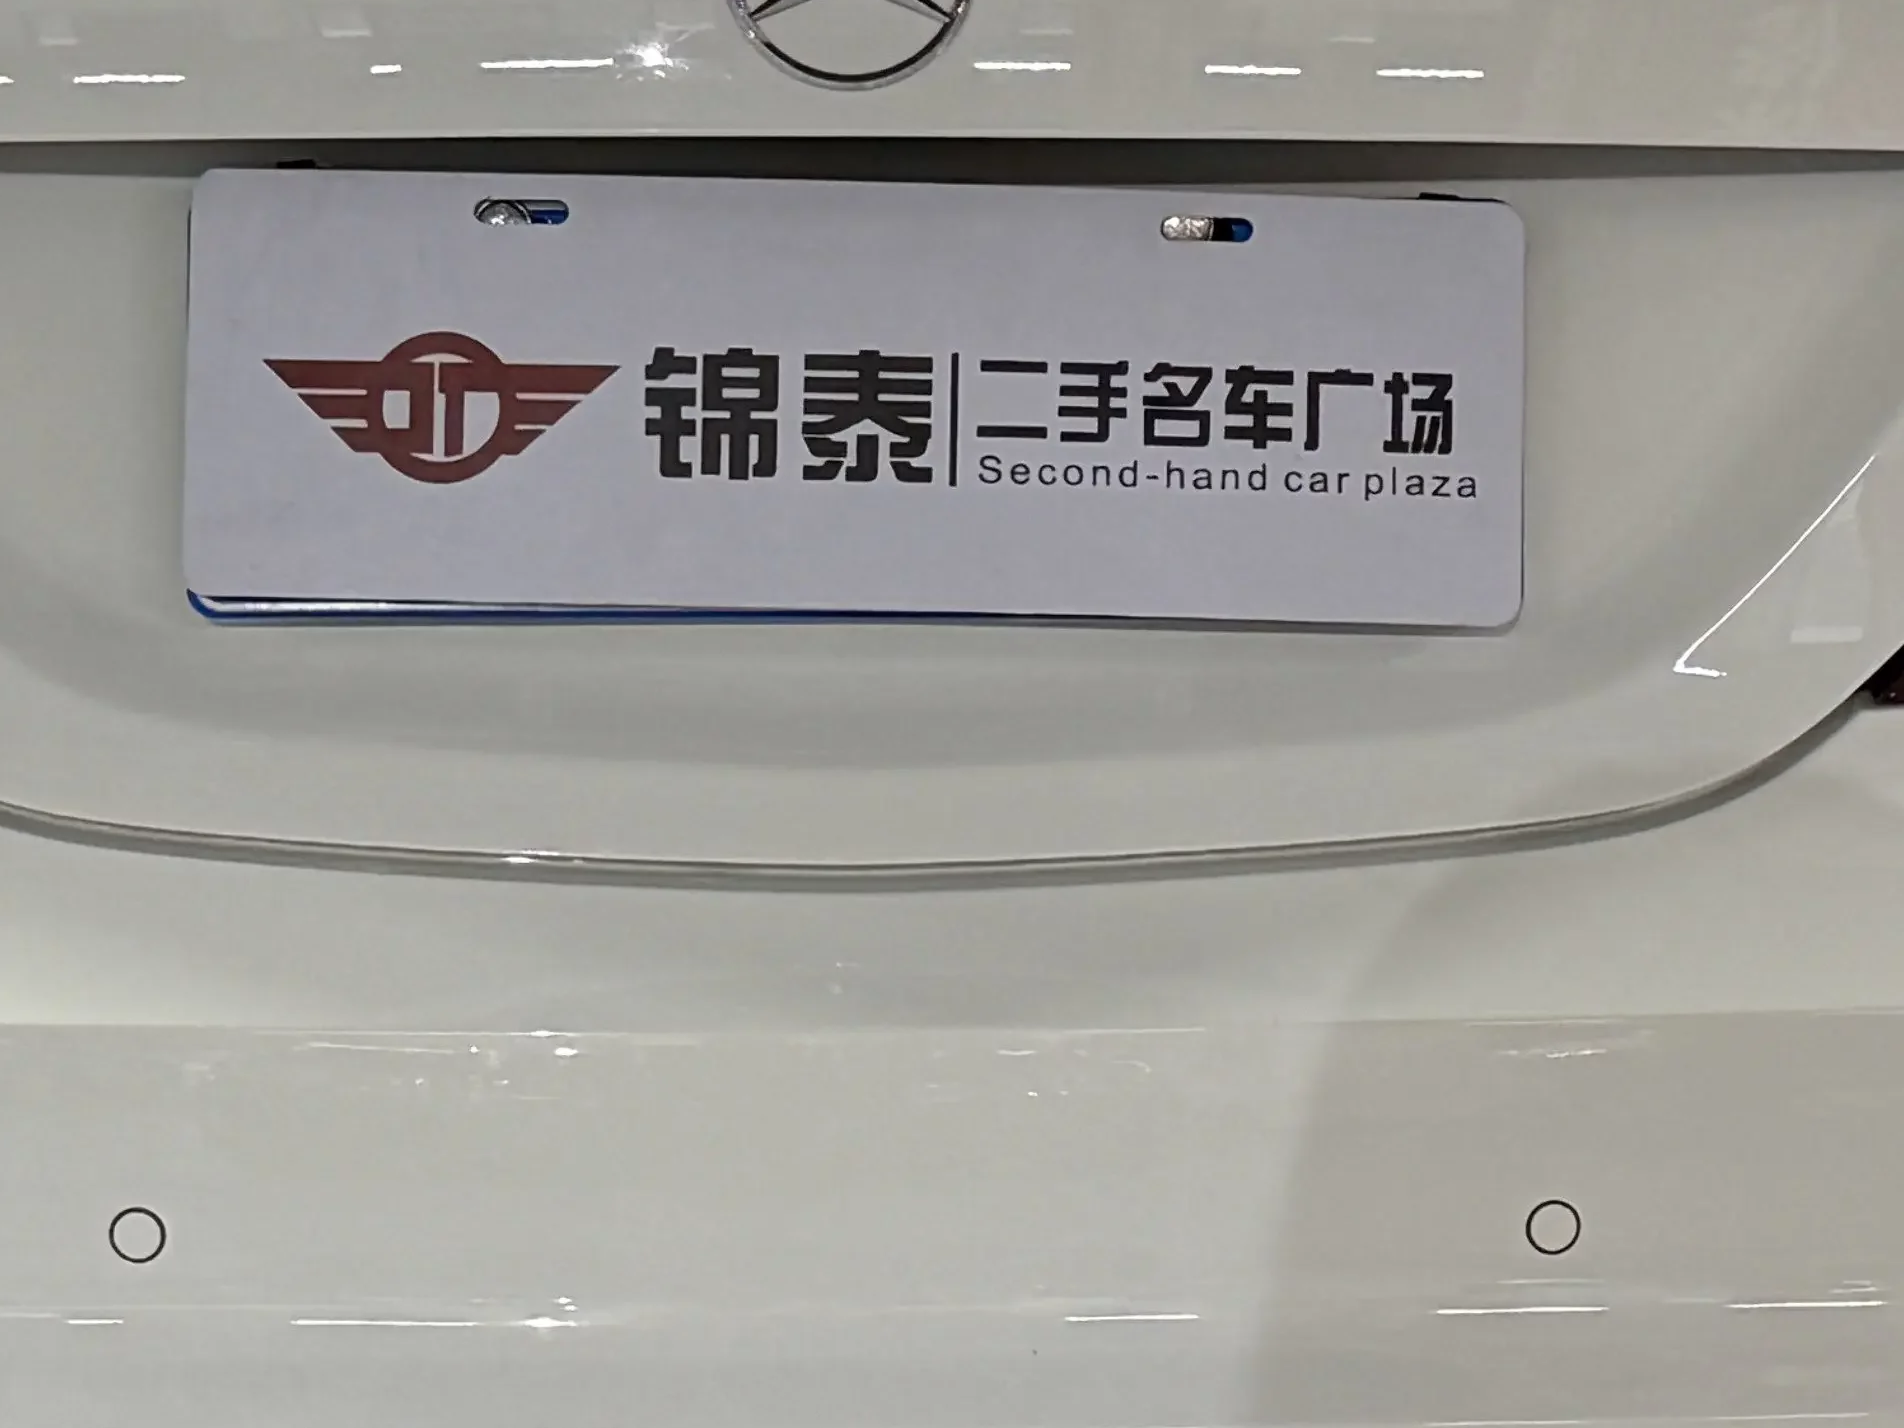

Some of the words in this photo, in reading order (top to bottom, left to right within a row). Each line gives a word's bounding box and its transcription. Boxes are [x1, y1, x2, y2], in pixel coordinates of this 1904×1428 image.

[644, 346, 934, 484] 锦泰
[976, 359, 1454, 456] 二手名车广场
[977, 454, 1269, 491] Second-hand
[1283, 472, 1351, 495] car
[1363, 466, 1478, 501] plaza
